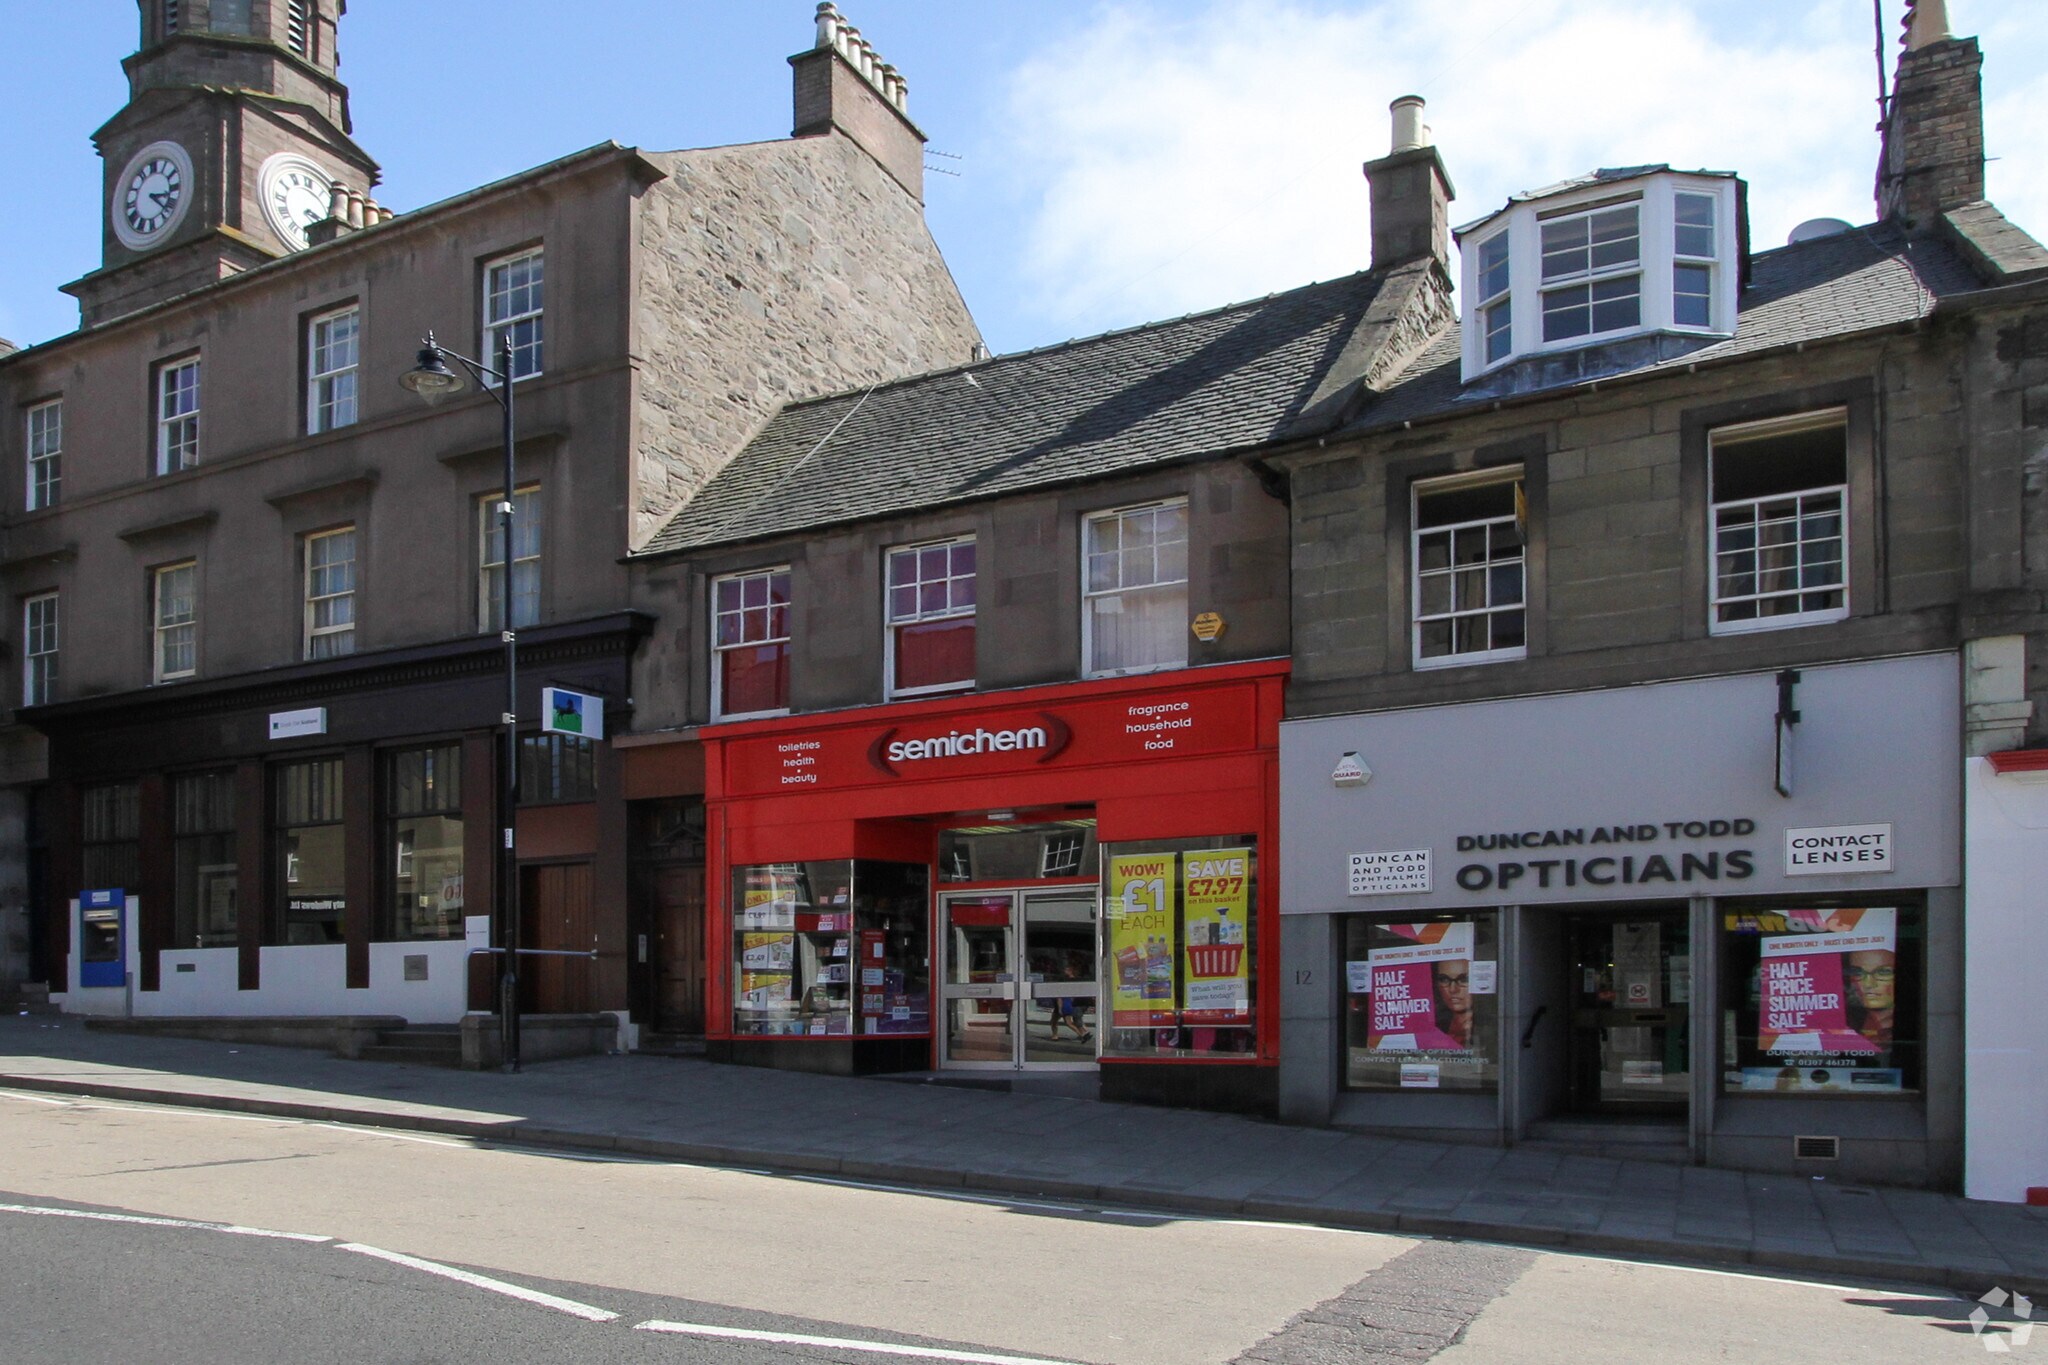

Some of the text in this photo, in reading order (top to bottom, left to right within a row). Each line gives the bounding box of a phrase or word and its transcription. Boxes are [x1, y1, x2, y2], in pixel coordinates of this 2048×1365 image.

[1128, 702, 1189, 716] fragrance
[1126, 717, 1192, 733] household
[778, 741, 821, 752] toiletries
[888, 727, 1047, 762] semichem
[1144, 738, 1174, 750] food
[783, 757, 815, 767] health
[781, 773, 817, 784] beauty
[1456, 818, 1755, 851] DUNCAN AND TODD
[1792, 834, 1885, 849] CONTACT
[1352, 853, 1426, 865] DUNCAN
[1792, 849, 1885, 864] LENSES
[1120, 863, 1165, 877] WOW!
[1187, 858, 1243, 878] SAVE
[1353, 864, 1426, 875] AND TODD
[1456, 850, 1754, 891] OPTICIANS
[1353, 874, 1426, 883] OPHTHALMIC
[1187, 877, 1243, 897] £7.97
[1353, 882, 1426, 891] OPTICIANS
[747, 893, 769, 904] ONLY
[1120, 878, 1165, 913] £1
[1120, 915, 1165, 931] EACH
[1296, 970, 1312, 985] 12
[1769, 961, 1808, 979] HALF
[1374, 970, 1406, 986] HALF
[1374, 985, 1410, 1001] PRICE
[1769, 978, 1814, 996] PRICE
[1374, 998, 1430, 1016] SUMMER
[1769, 994, 1839, 1013] SUMMER
